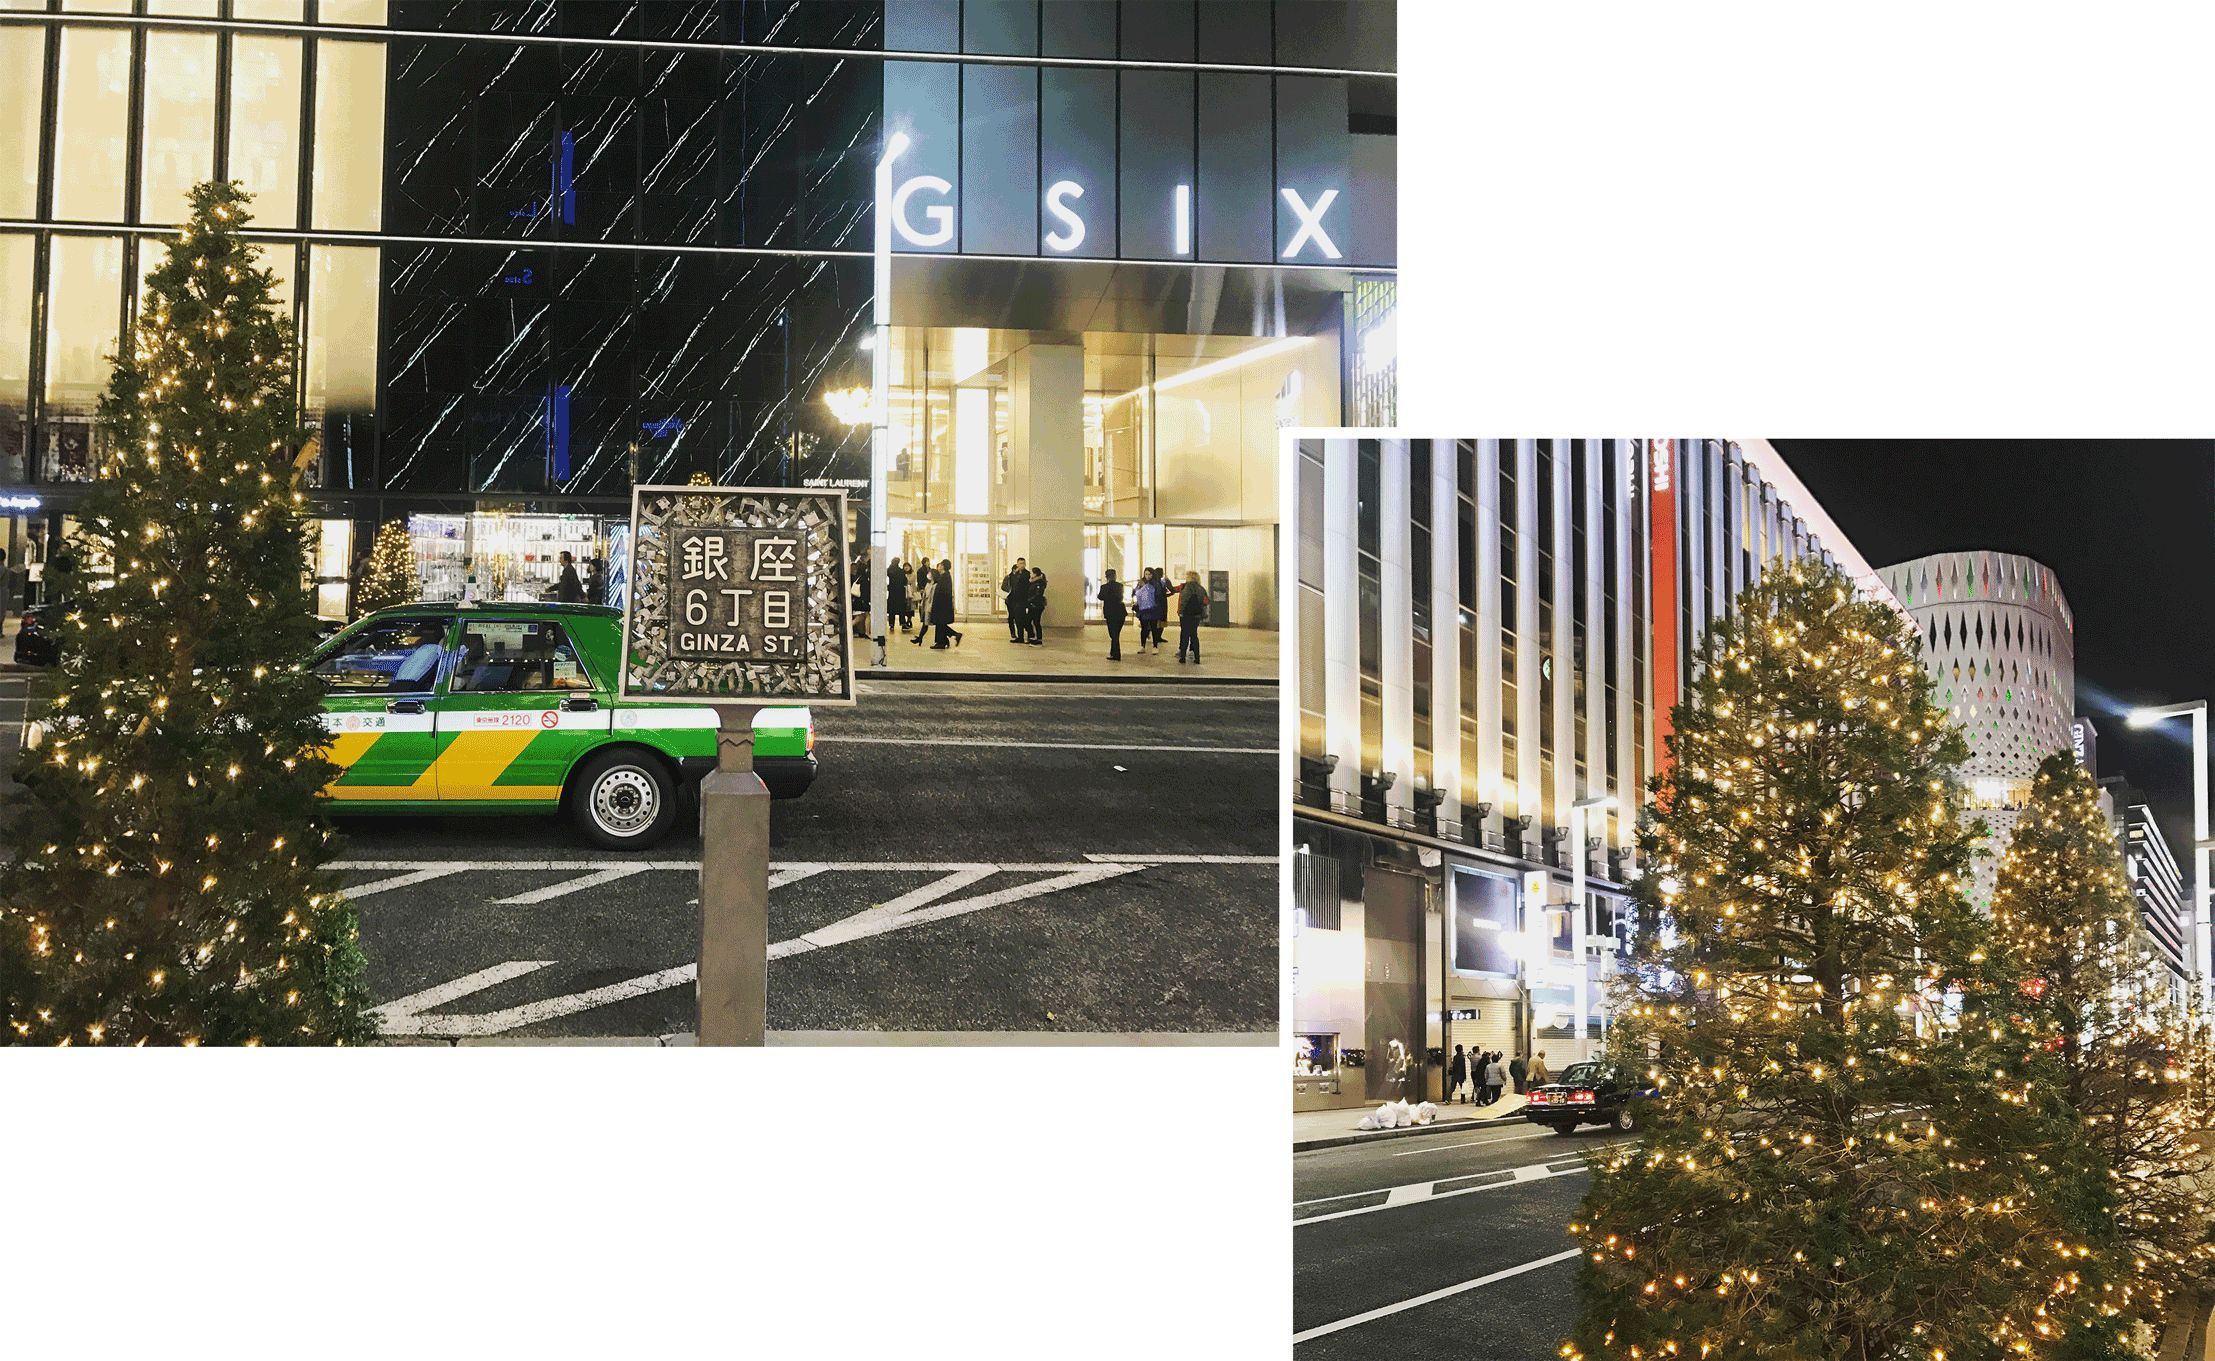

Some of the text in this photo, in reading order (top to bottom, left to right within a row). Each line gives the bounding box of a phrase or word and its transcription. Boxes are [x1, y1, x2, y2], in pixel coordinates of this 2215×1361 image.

[803, 479, 869, 488] SAINT LAURENT
[681, 535, 798, 581] 銀座
[685, 588, 790, 629] 6丁目
[680, 632, 750, 652] GINZA
[362, 717, 386, 727] 交通
[502, 714, 530, 726] 2120
[2073, 723, 2085, 766] GINZA
